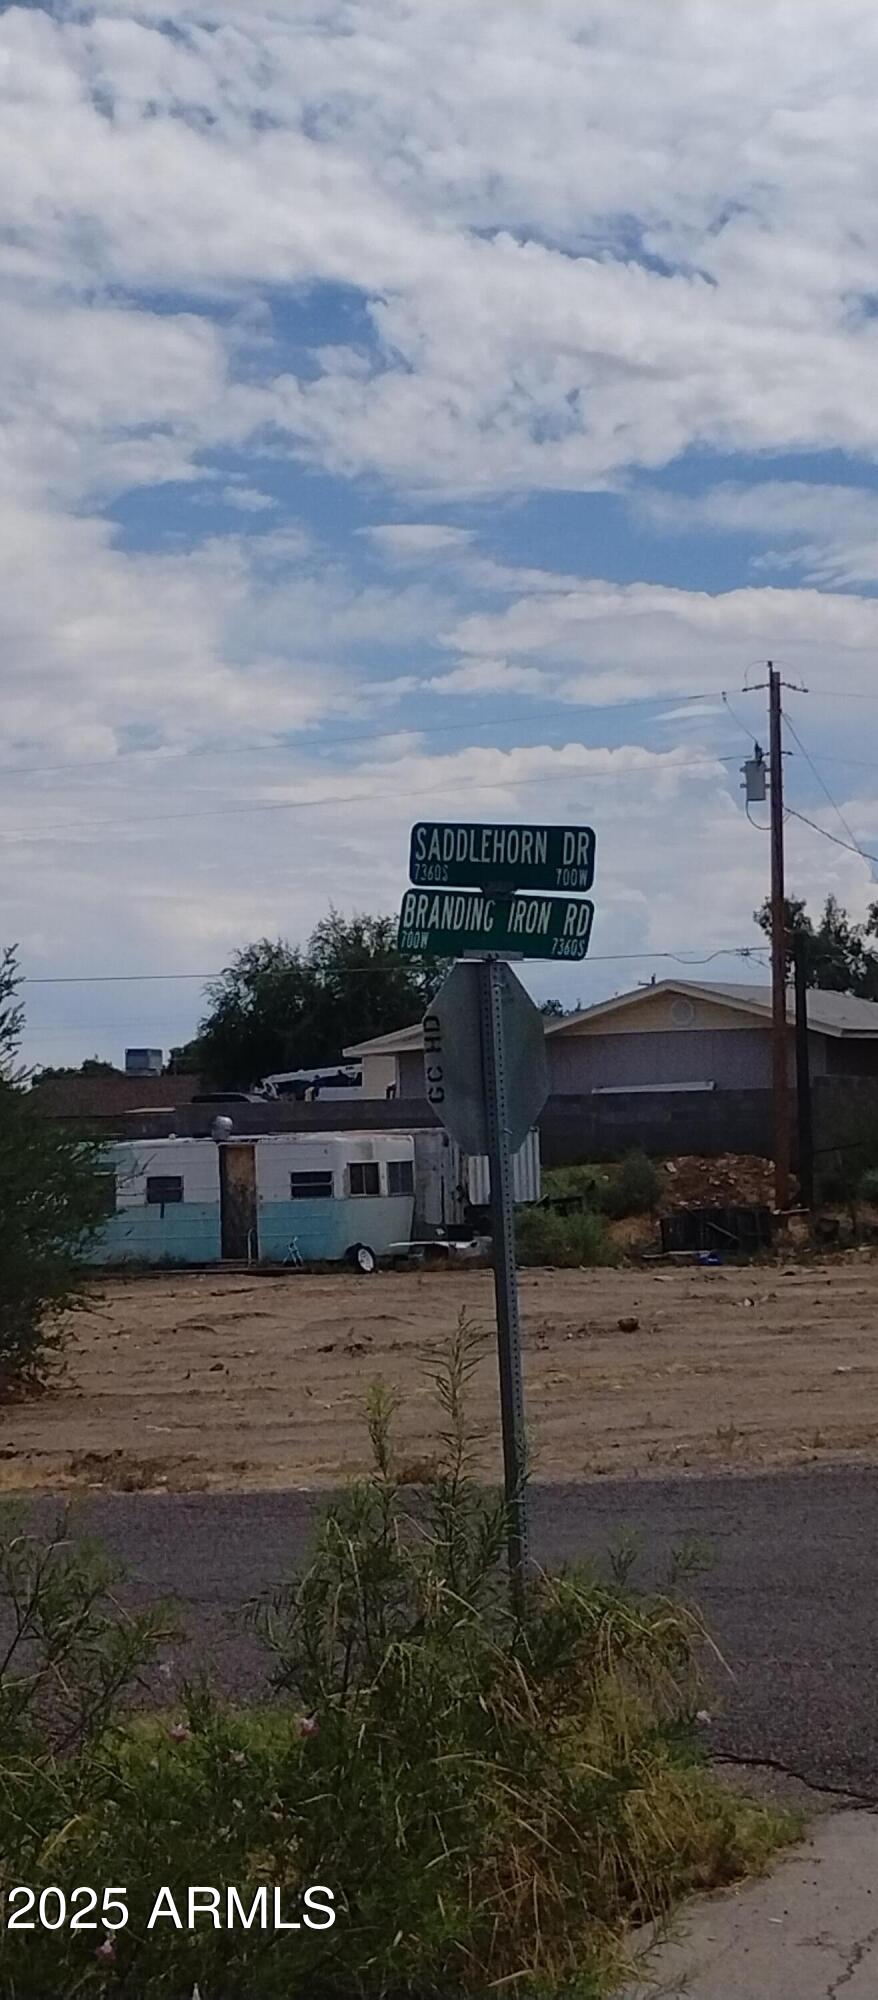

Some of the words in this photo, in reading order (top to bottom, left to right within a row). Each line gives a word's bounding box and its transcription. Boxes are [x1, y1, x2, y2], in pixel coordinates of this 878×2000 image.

[415, 827, 548, 865] SADDLEHORN
[562, 831, 590, 866] DR
[414, 863, 449, 882] 7360S
[555, 868, 588, 887] 700W
[402, 894, 496, 932] BRANDING
[507, 900, 552, 935] IRON
[562, 903, 591, 937] RD
[400, 930, 430, 949] 700W
[552, 937, 586, 957] 7360S
[423, 1015, 442, 1053] HD
[427, 1065, 445, 1104] GC
